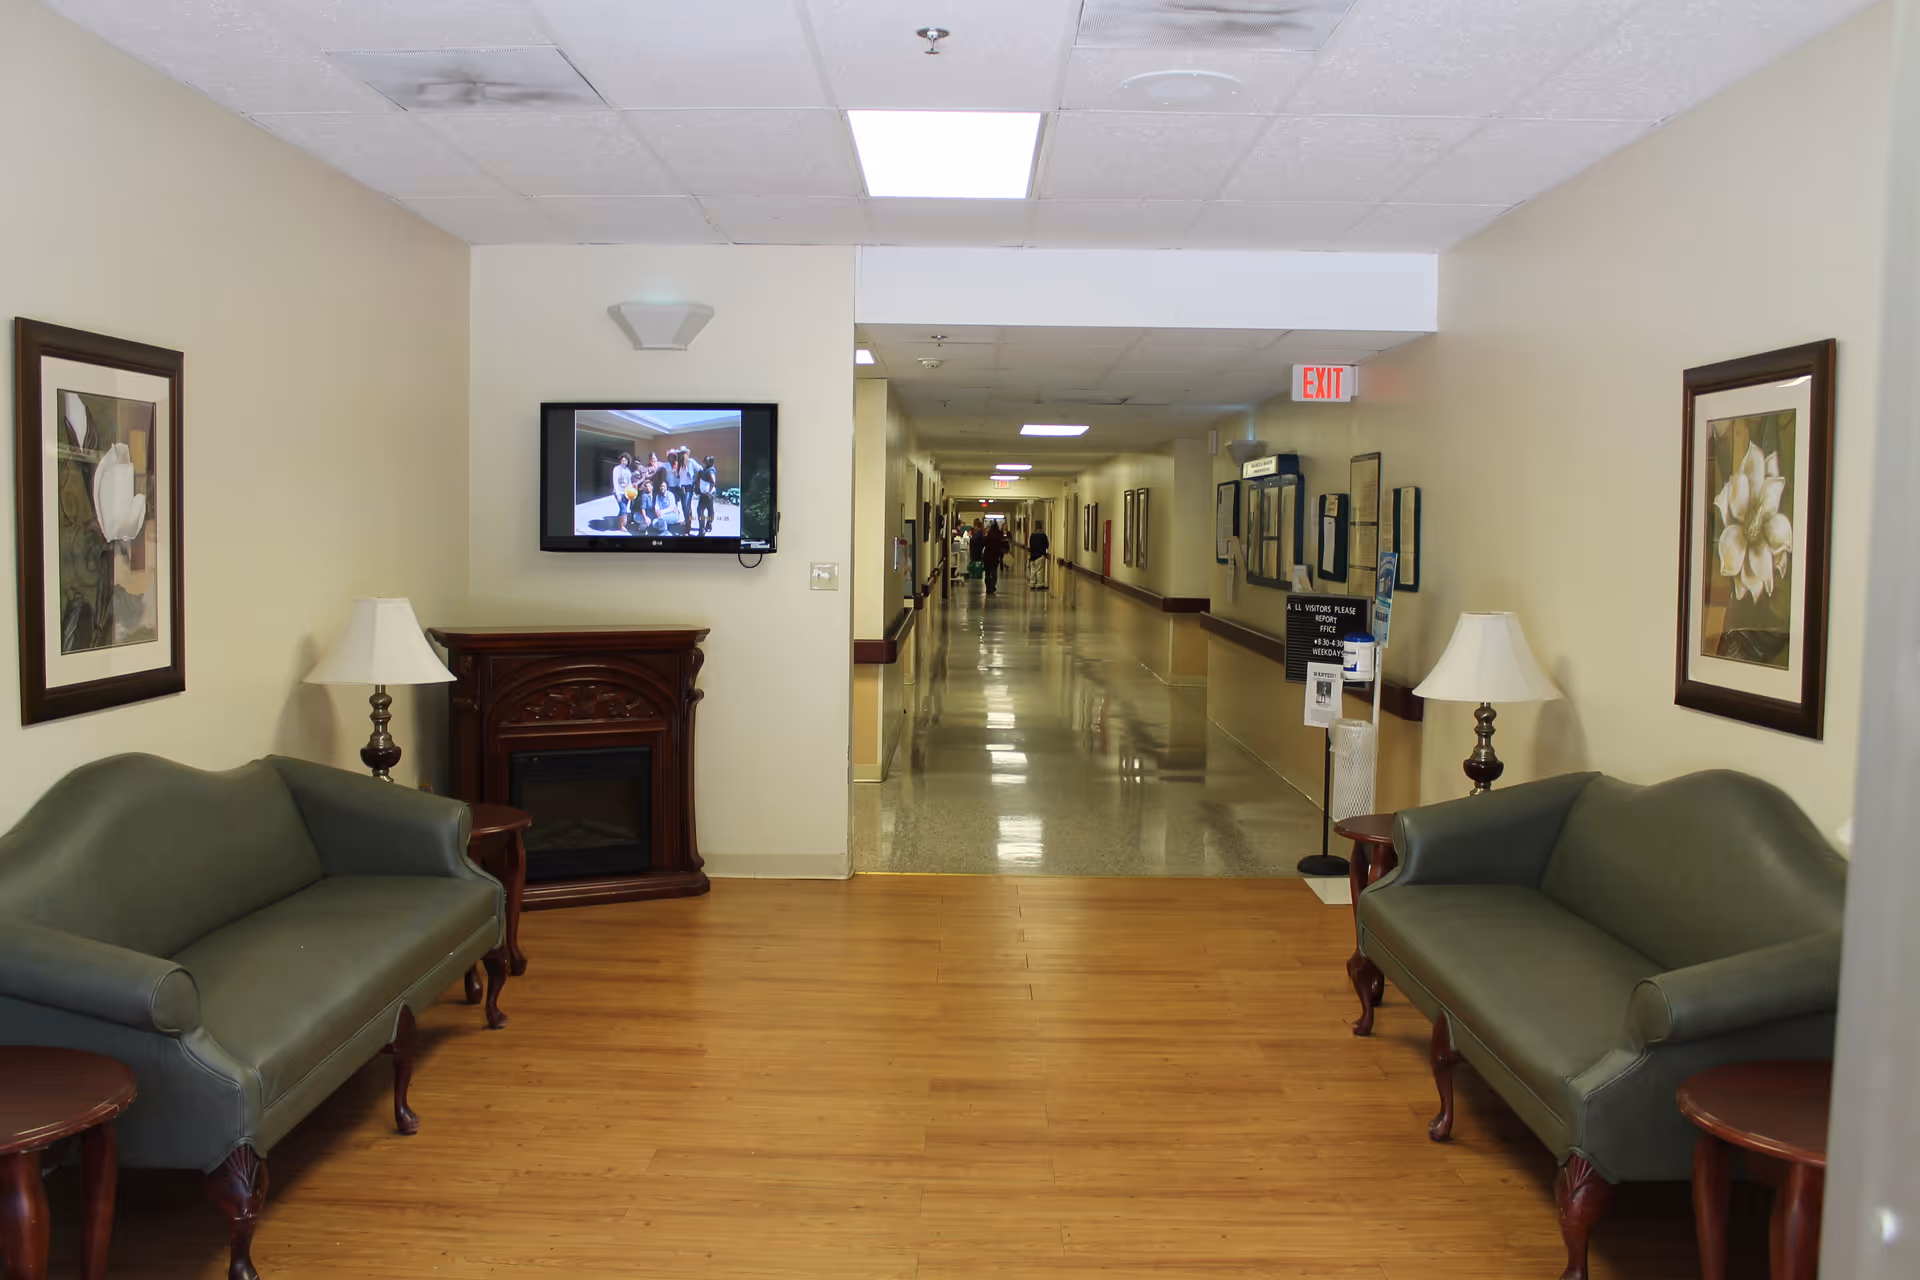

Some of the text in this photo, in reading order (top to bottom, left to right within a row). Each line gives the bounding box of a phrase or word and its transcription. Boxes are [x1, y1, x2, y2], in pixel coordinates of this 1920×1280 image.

[1303, 367, 1344, 399] EXIT
[1305, 604, 1331, 613] VISITORS
[1334, 606, 1356, 615] PLEASE
[1315, 614, 1337, 624] REPORT
[1320, 625, 1336, 633] FFICE
[1312, 648, 1344, 658] WEEKDAYS
